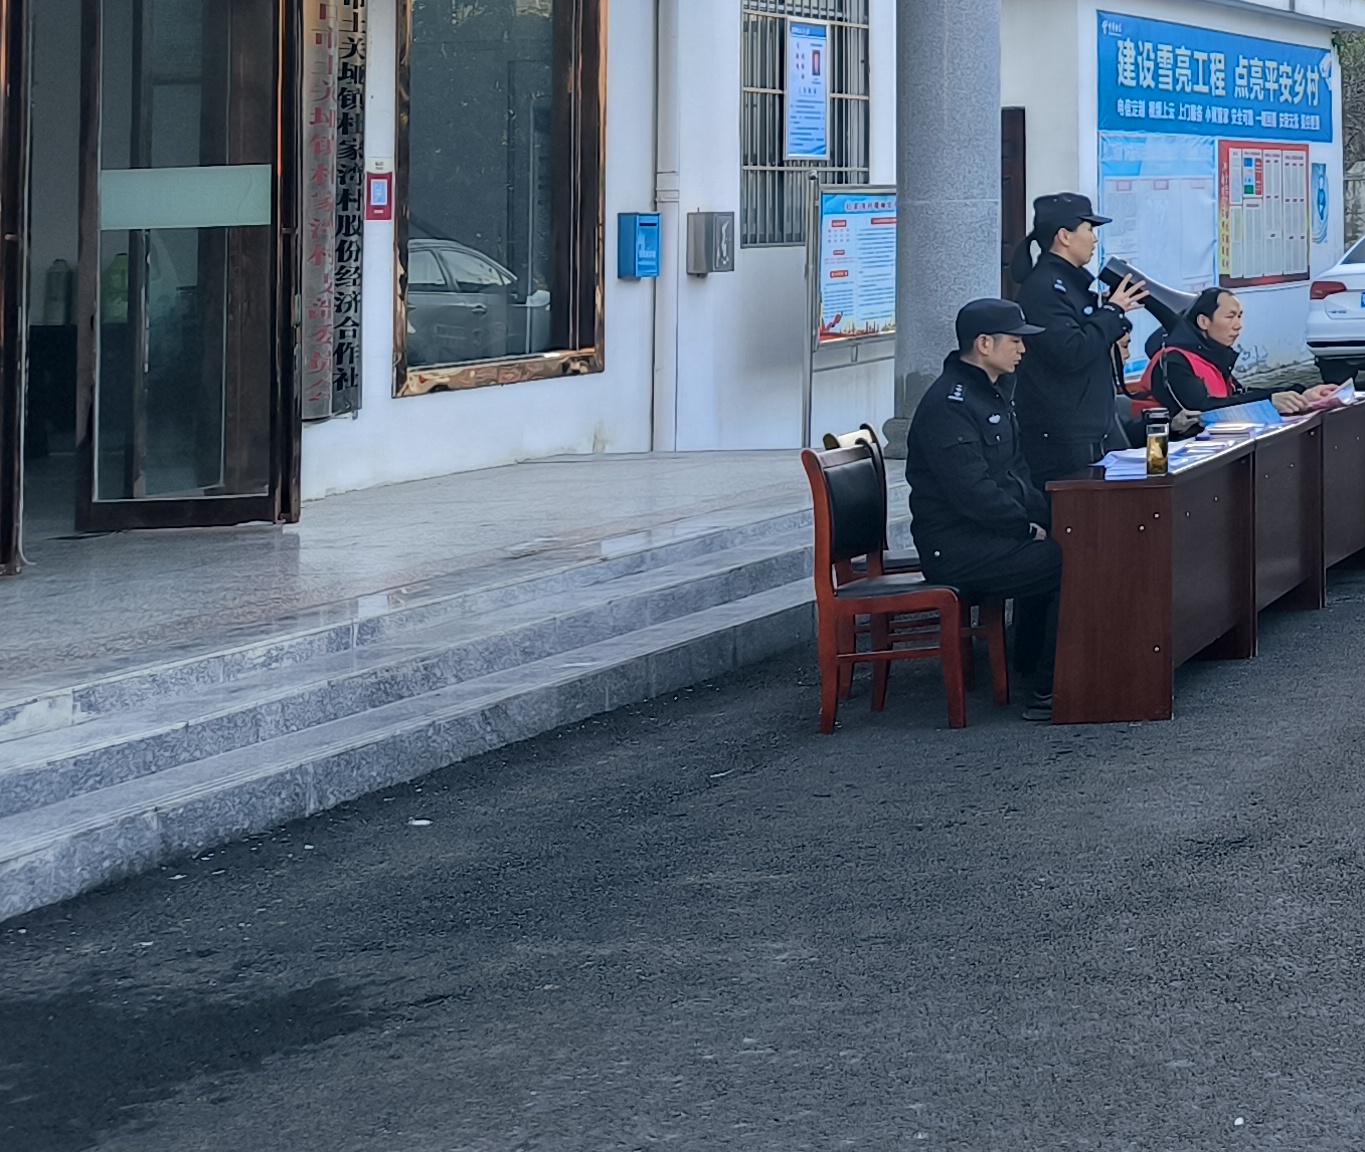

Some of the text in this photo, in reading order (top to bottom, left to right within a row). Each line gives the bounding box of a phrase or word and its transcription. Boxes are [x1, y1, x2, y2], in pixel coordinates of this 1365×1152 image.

[1117, 38, 1320, 106] 建设雪亮工程 点亮平安乡村
